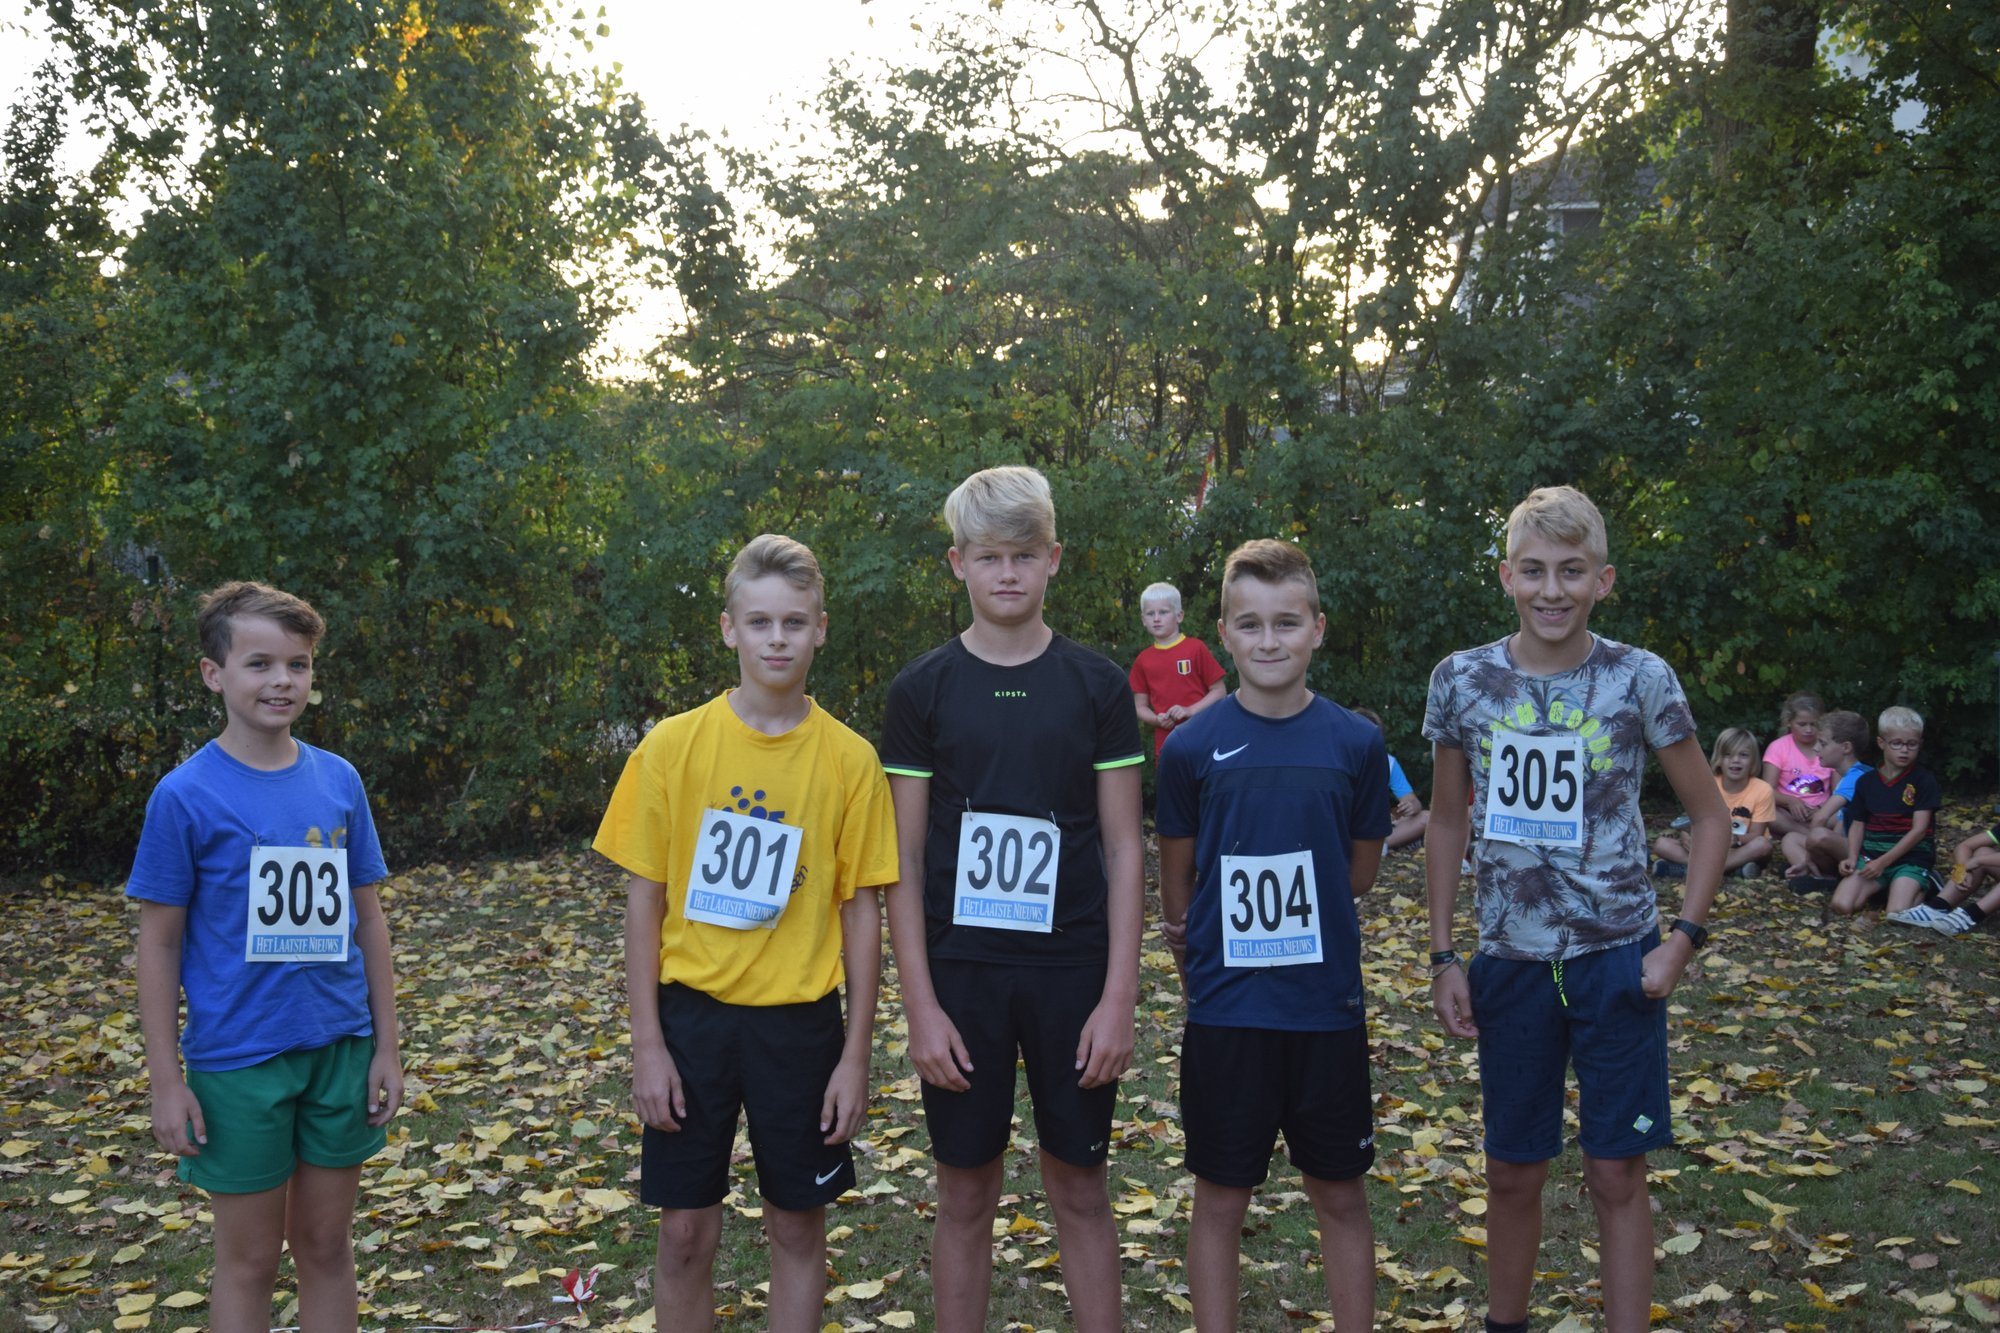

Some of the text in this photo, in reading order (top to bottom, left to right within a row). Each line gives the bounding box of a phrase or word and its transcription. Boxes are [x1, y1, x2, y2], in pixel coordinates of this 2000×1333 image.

[1497, 744, 1578, 813] 305
[1494, 815, 1573, 839] HET LAATSTE NIEUWS
[701, 819, 789, 896] 301
[967, 825, 1054, 895] 302
[257, 860, 342, 926] 303
[694, 891, 776, 920] HET LAATSTE NIEUWS
[963, 898, 1044, 921] HET LAATSTE NIEUWS
[1229, 865, 1313, 933] 304
[256, 936, 339, 953] HET LAATSTE NIEUWS
[1232, 938, 1313, 957] HET LAATSTE NIEUWS
